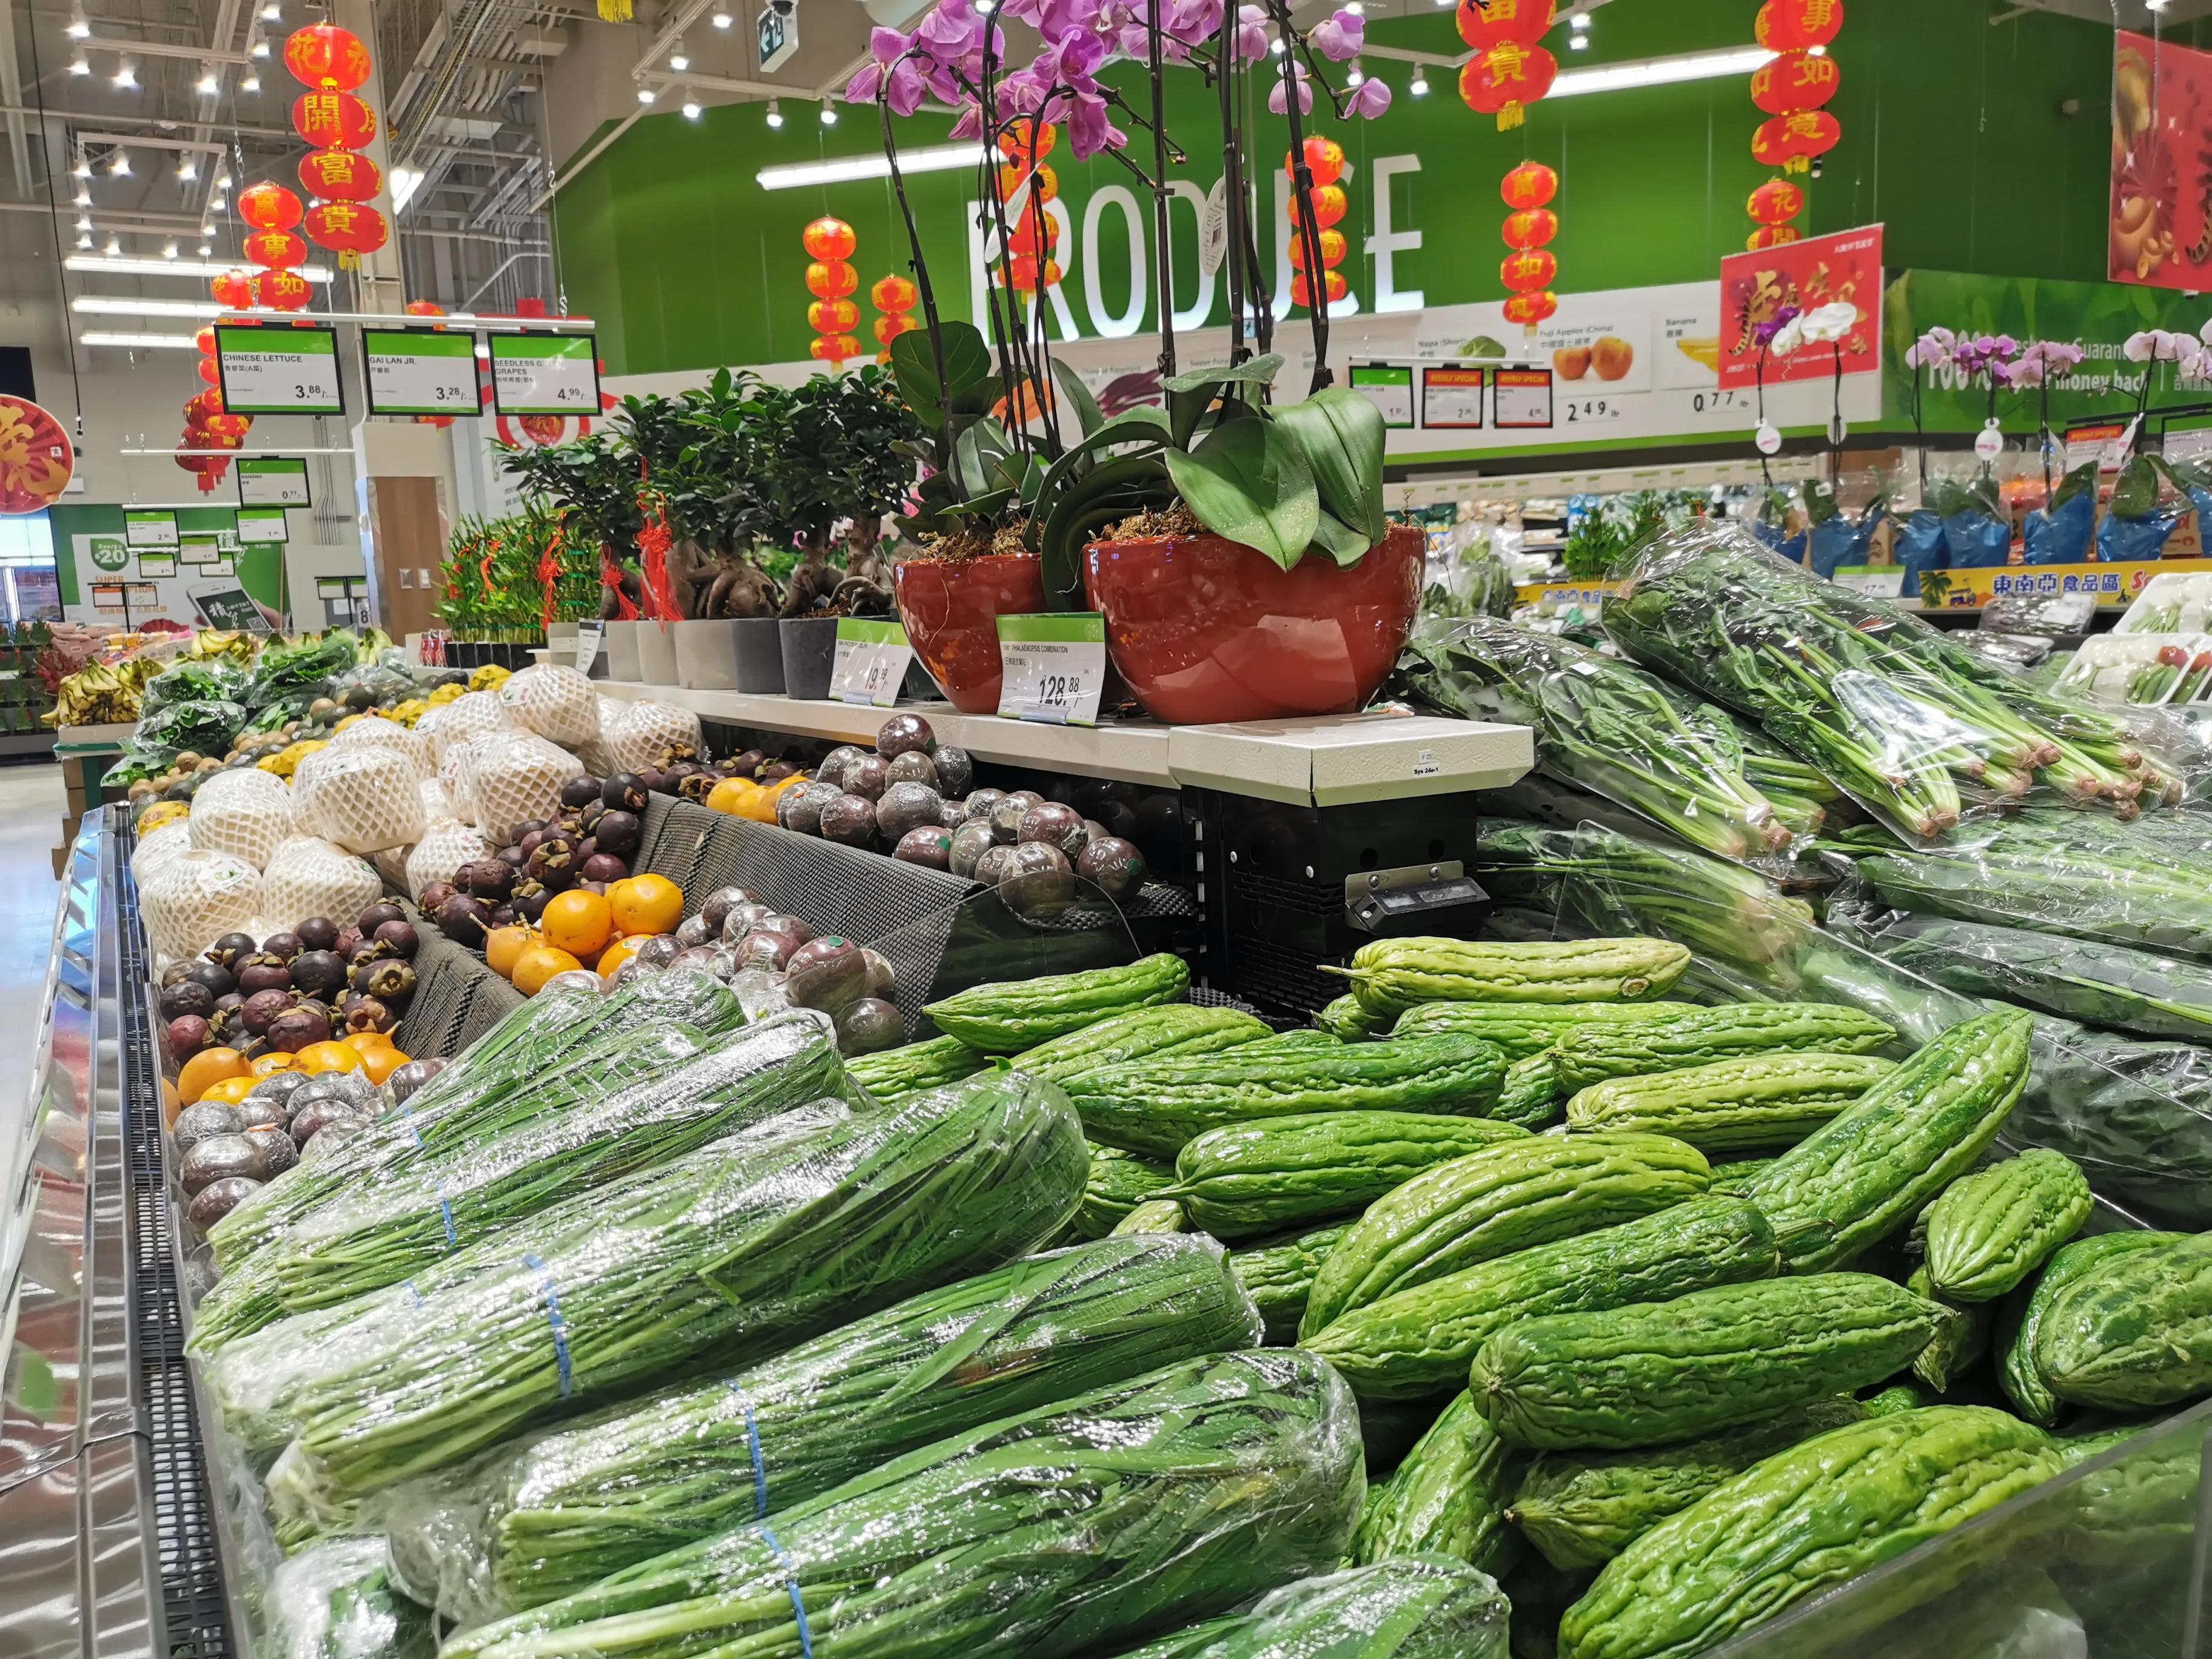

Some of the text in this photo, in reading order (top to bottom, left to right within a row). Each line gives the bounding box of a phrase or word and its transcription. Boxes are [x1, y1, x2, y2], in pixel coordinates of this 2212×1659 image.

[1992, 573, 2120, 594] 東南亞食品區
